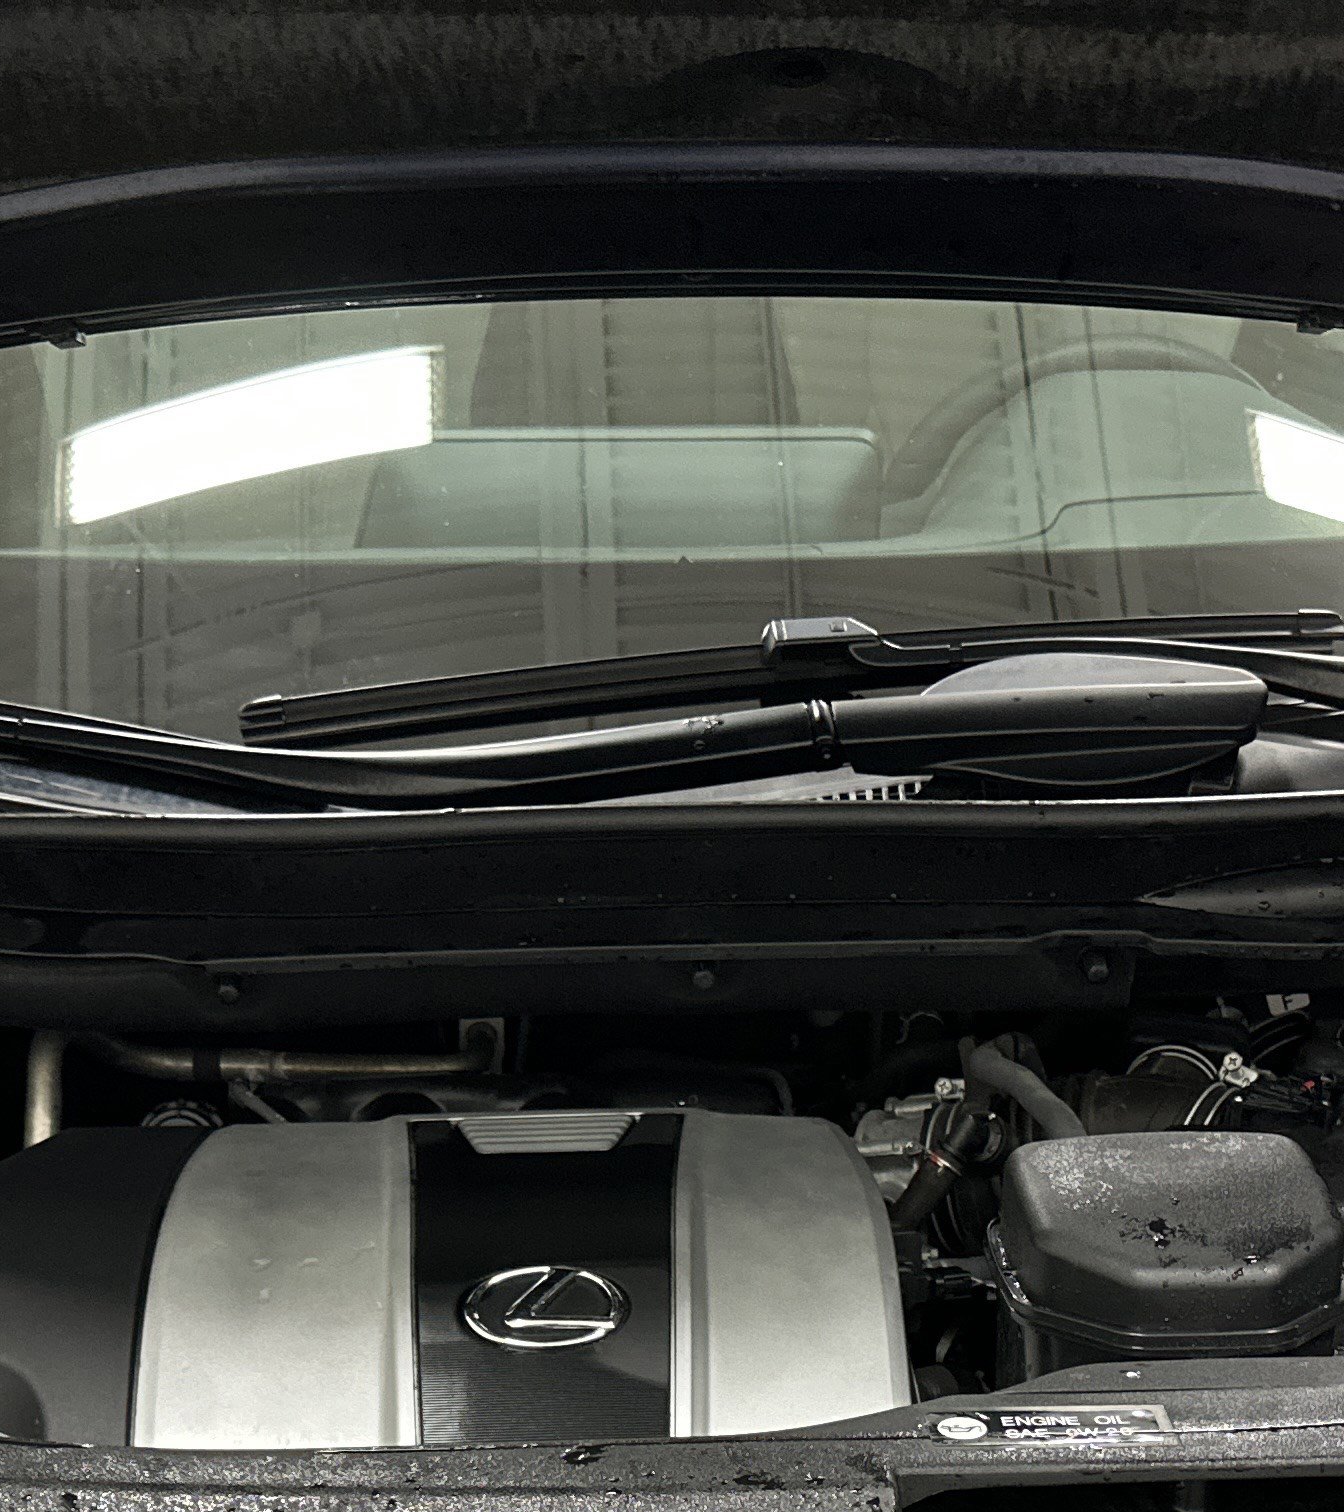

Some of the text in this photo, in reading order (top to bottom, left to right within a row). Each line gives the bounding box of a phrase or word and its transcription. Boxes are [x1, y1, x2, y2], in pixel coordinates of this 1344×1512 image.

[1000, 1414, 1131, 1427] ENGINE OIL
[1005, 1427, 1050, 1439] SAE
